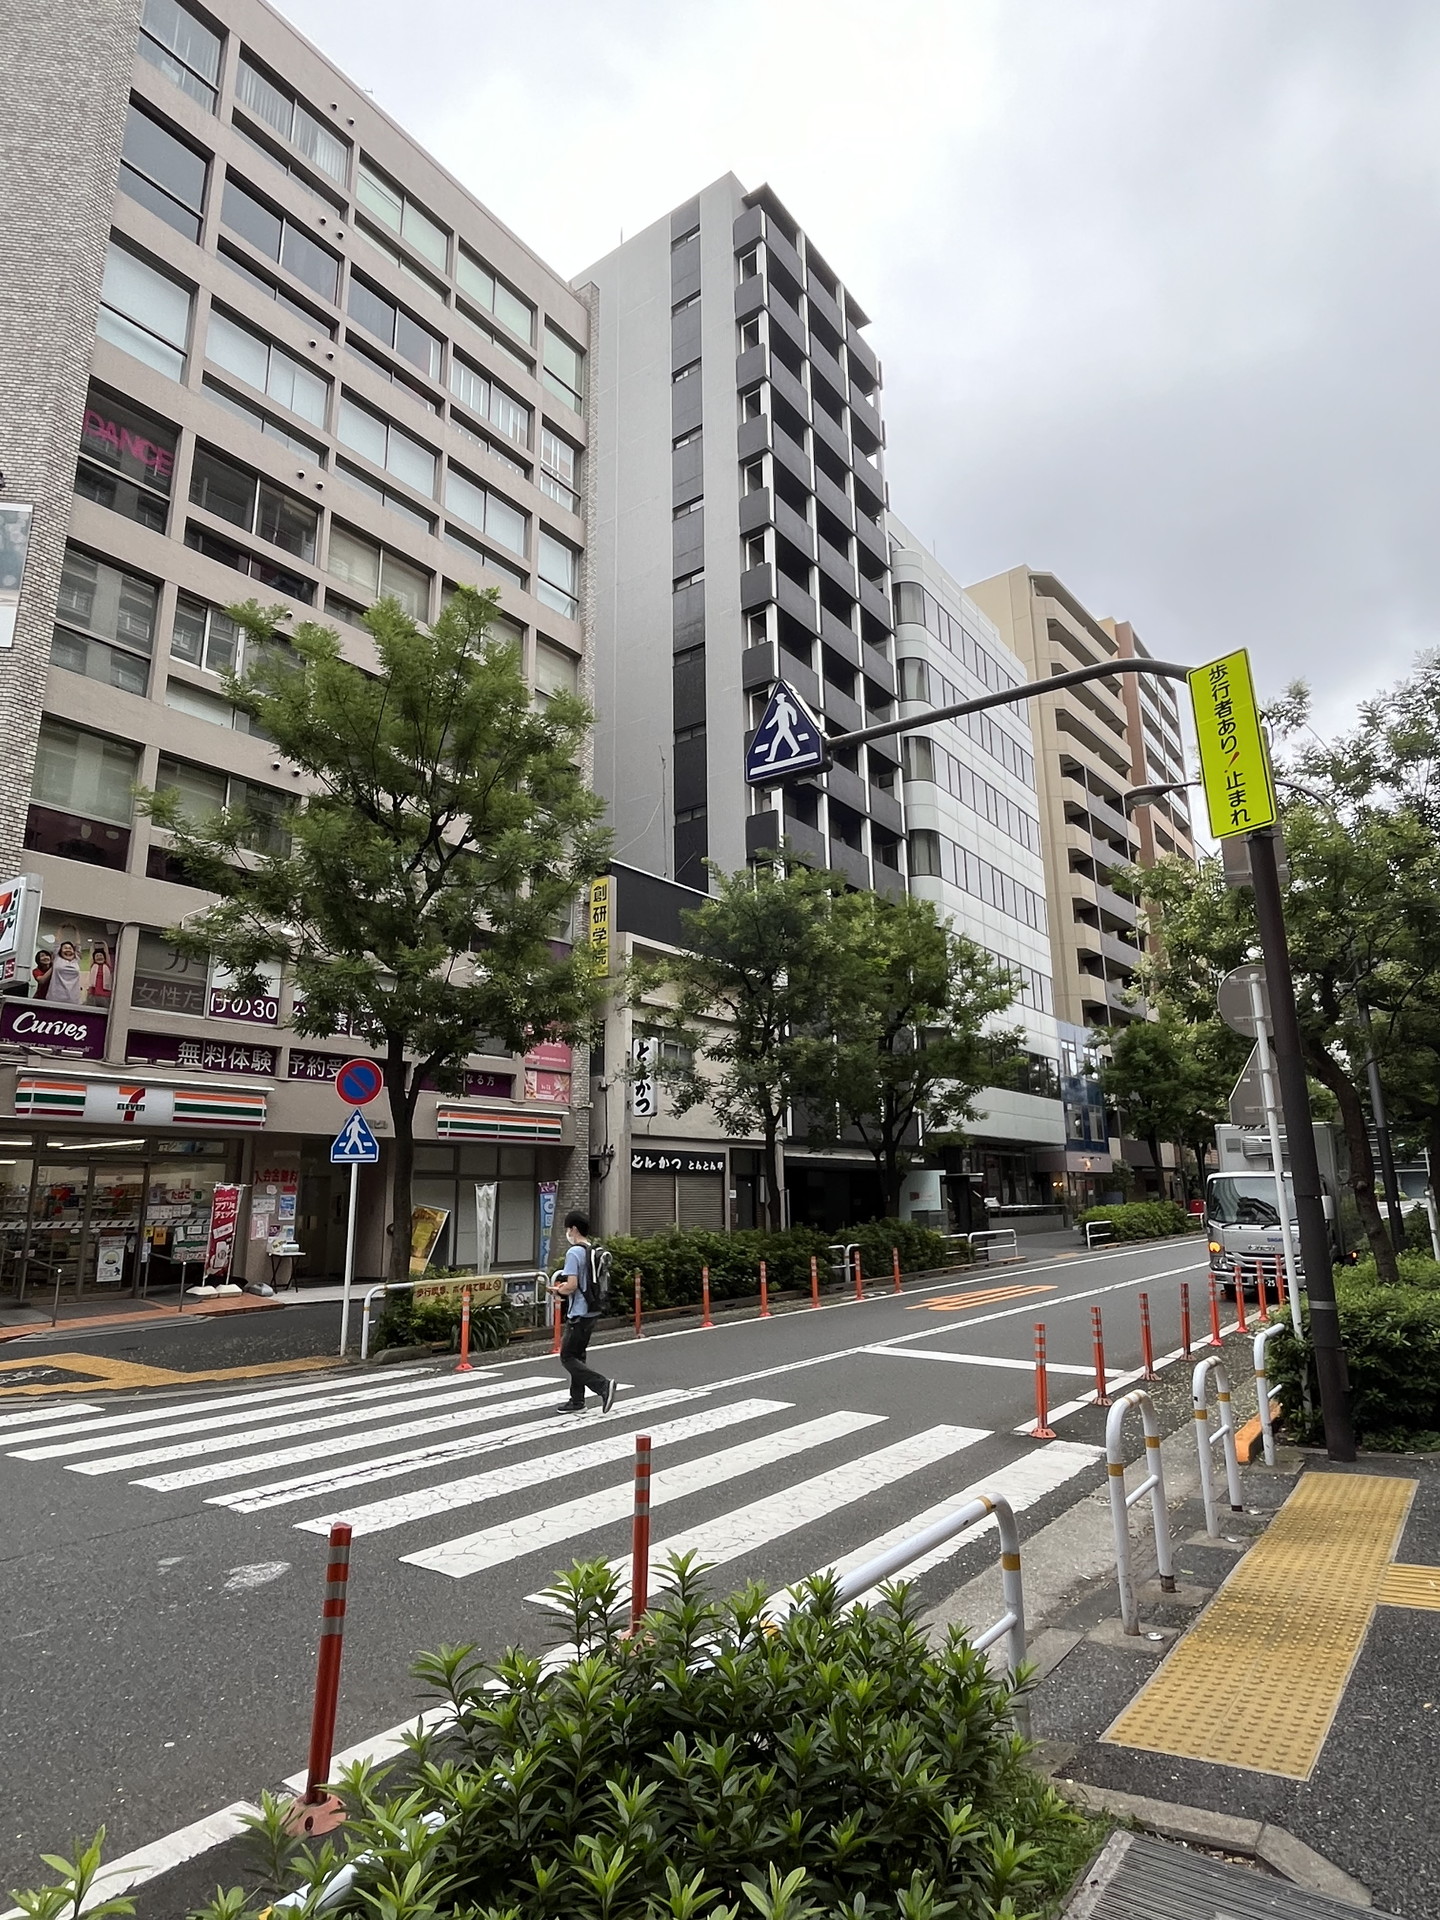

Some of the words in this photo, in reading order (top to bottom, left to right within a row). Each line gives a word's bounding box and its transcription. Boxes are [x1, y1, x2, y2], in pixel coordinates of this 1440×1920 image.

[82, 409, 175, 476] DANCE
[12, 1011, 87, 1041] Curves
[177, 1041, 273, 1073] 無料体験
[635, 1042, 652, 1114] とかつ
[631, 1154, 682, 1170] とんかつ
